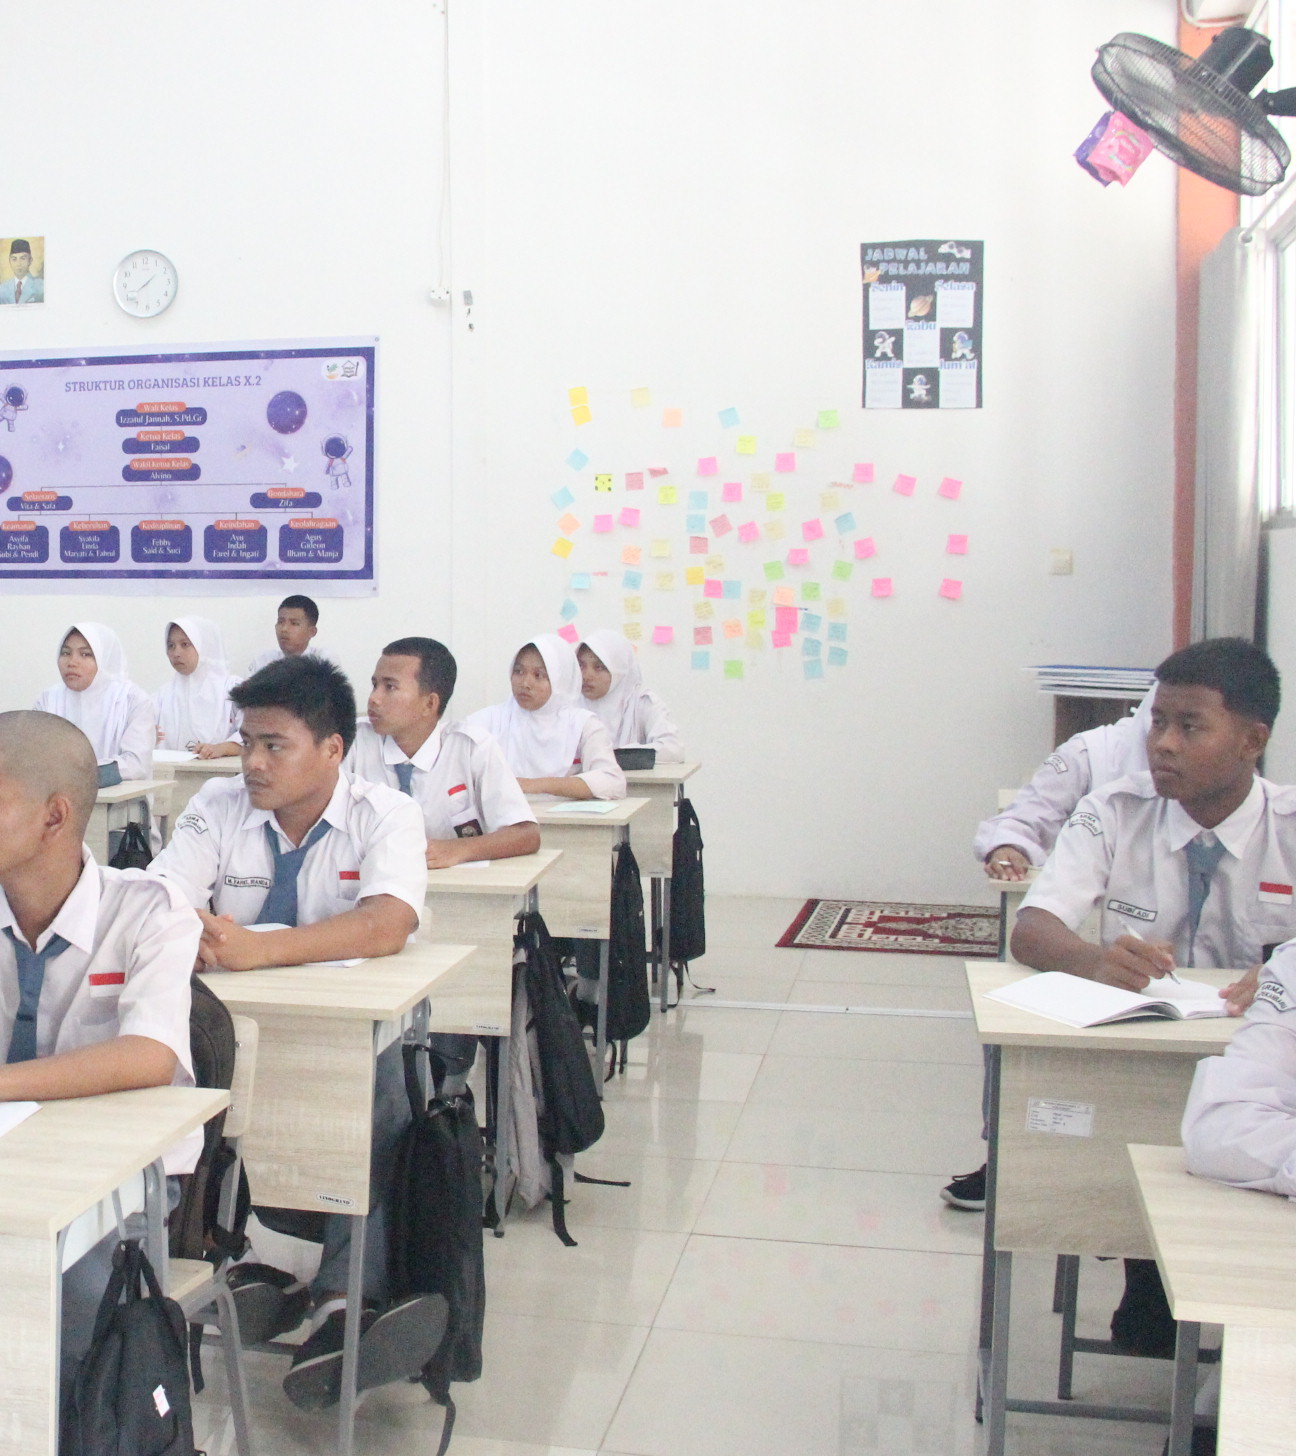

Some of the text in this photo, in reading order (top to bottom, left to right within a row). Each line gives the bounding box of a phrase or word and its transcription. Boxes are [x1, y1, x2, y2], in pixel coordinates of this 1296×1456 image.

[865, 247, 928, 261] JADWAL
[879, 261, 970, 275] PELAJARAN
[871, 279, 976, 292] Senin Selasa
[65, 375, 261, 392] STRUKTUR ORGANISASI KELAS X.2
[160, 403, 178, 411] Kelas
[150, 471, 171, 479] Alvino
[290, 520, 336, 528] Keolahragaan
[305, 533, 322, 541] Agus
[317, 550, 339, 558] Manja
[1117, 904, 1136, 914] SUBI
